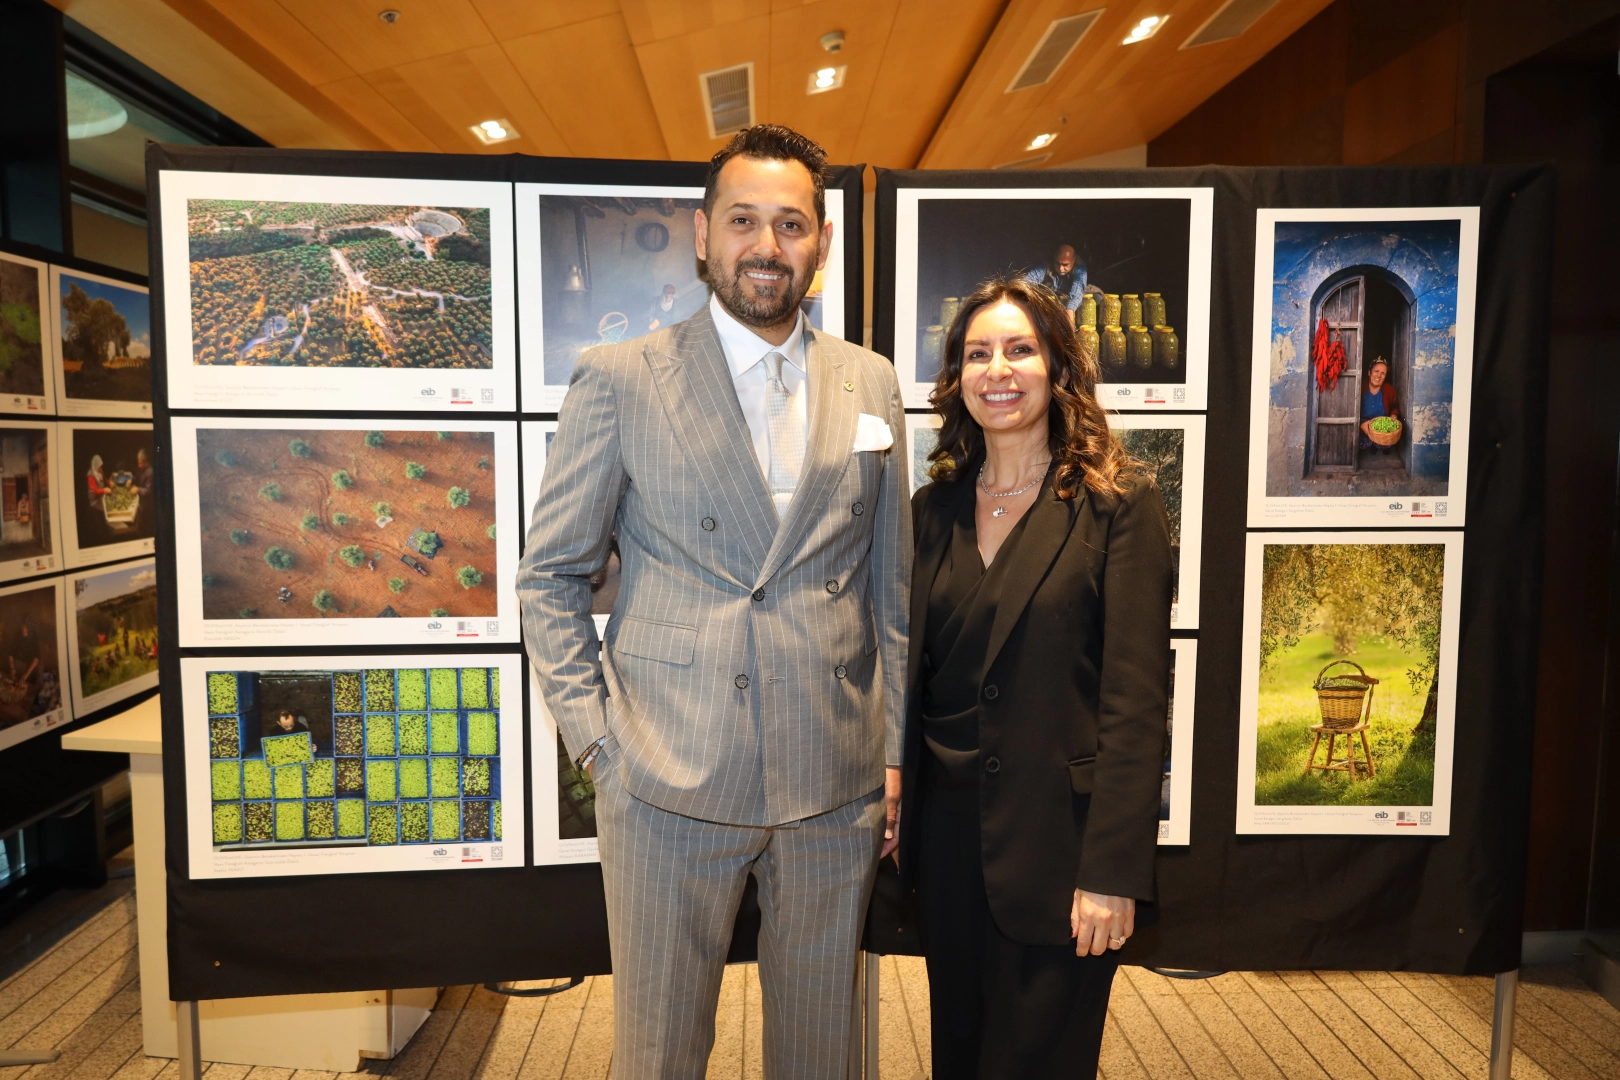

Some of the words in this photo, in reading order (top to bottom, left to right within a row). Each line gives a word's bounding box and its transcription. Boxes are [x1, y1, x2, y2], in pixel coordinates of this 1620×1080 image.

[421, 388, 436, 396] eib
[1117, 388, 1131, 396] eib
[1389, 502, 1403, 510] eib
[428, 621, 442, 630] eib
[1375, 811, 1388, 819] eib
[433, 848, 447, 856] eib
